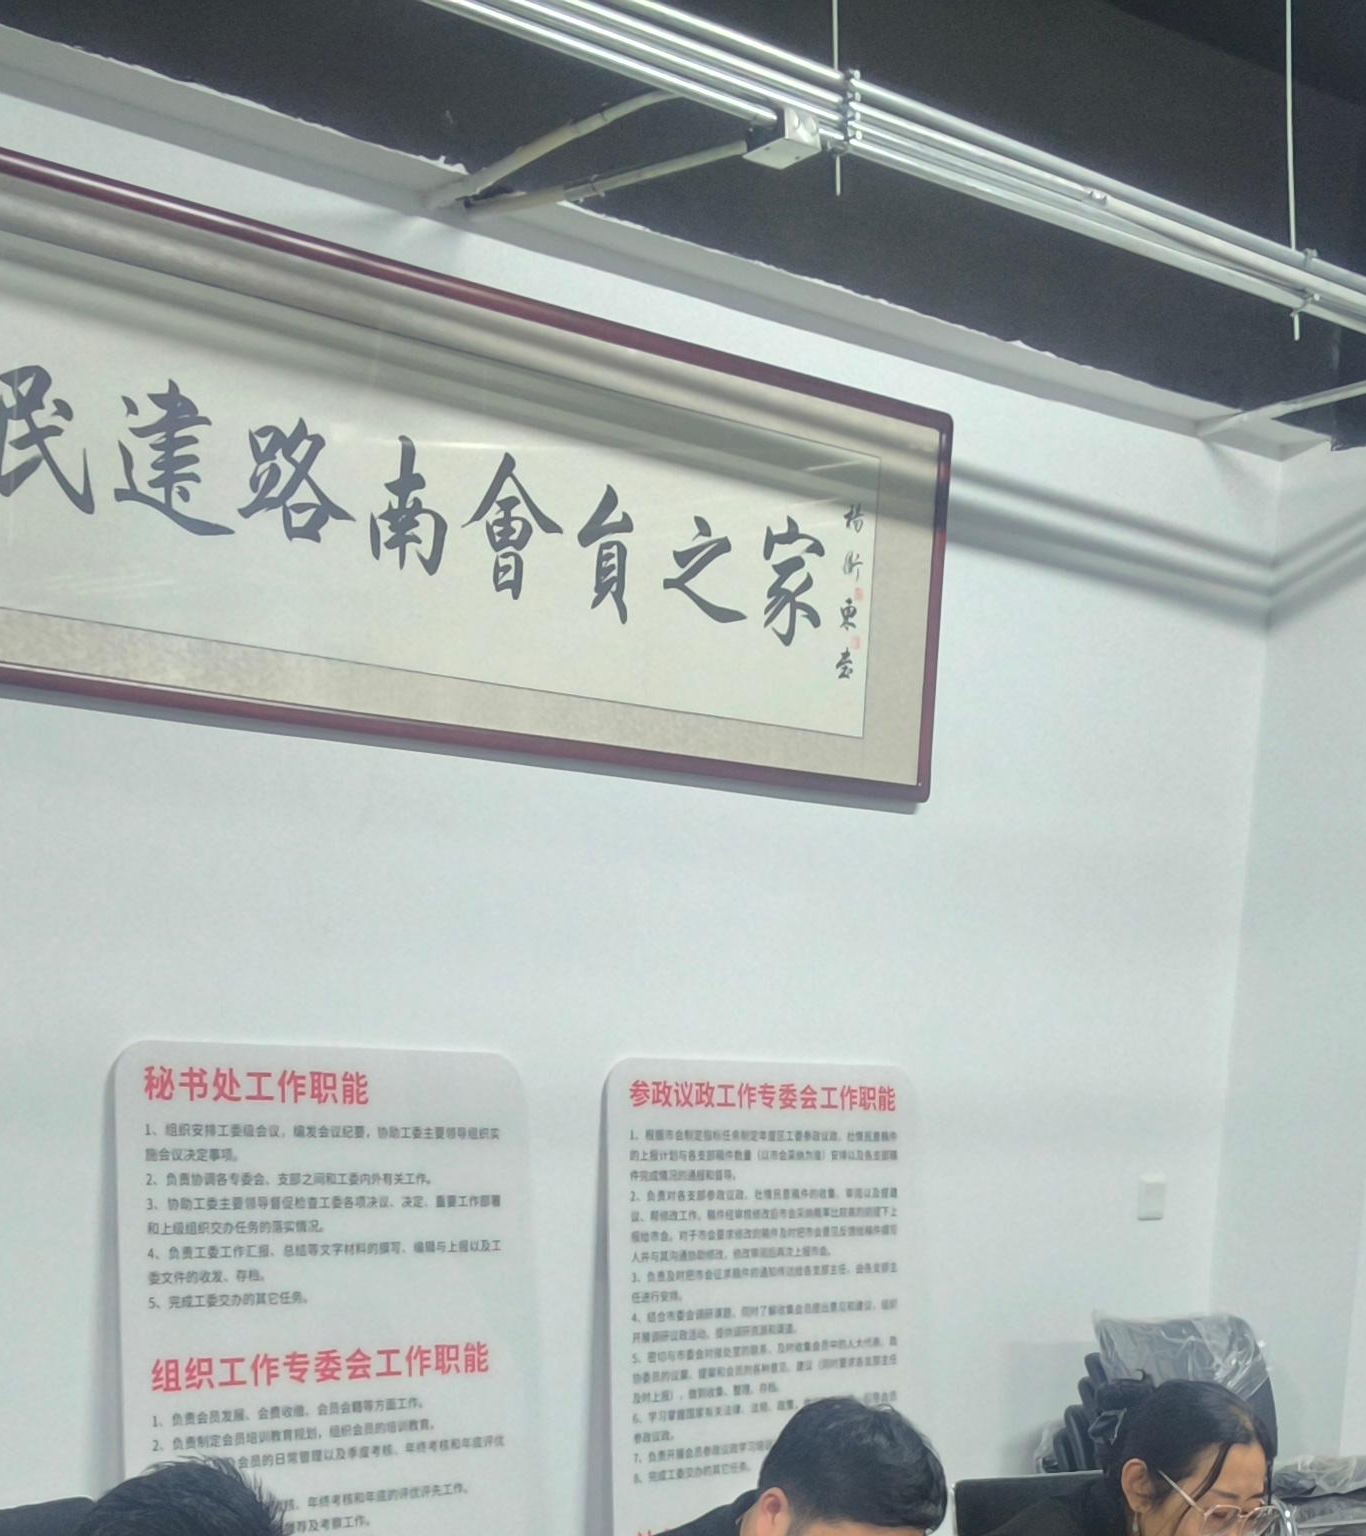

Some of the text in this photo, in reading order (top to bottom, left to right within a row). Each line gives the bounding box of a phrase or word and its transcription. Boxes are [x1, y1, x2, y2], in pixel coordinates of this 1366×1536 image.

[143, 1065, 370, 1106] 秘书处工作职能
[628, 1080, 896, 1112] 参政议政工作专委会工作职能
[150, 1341, 490, 1392] 组织工作专委会工作职能
